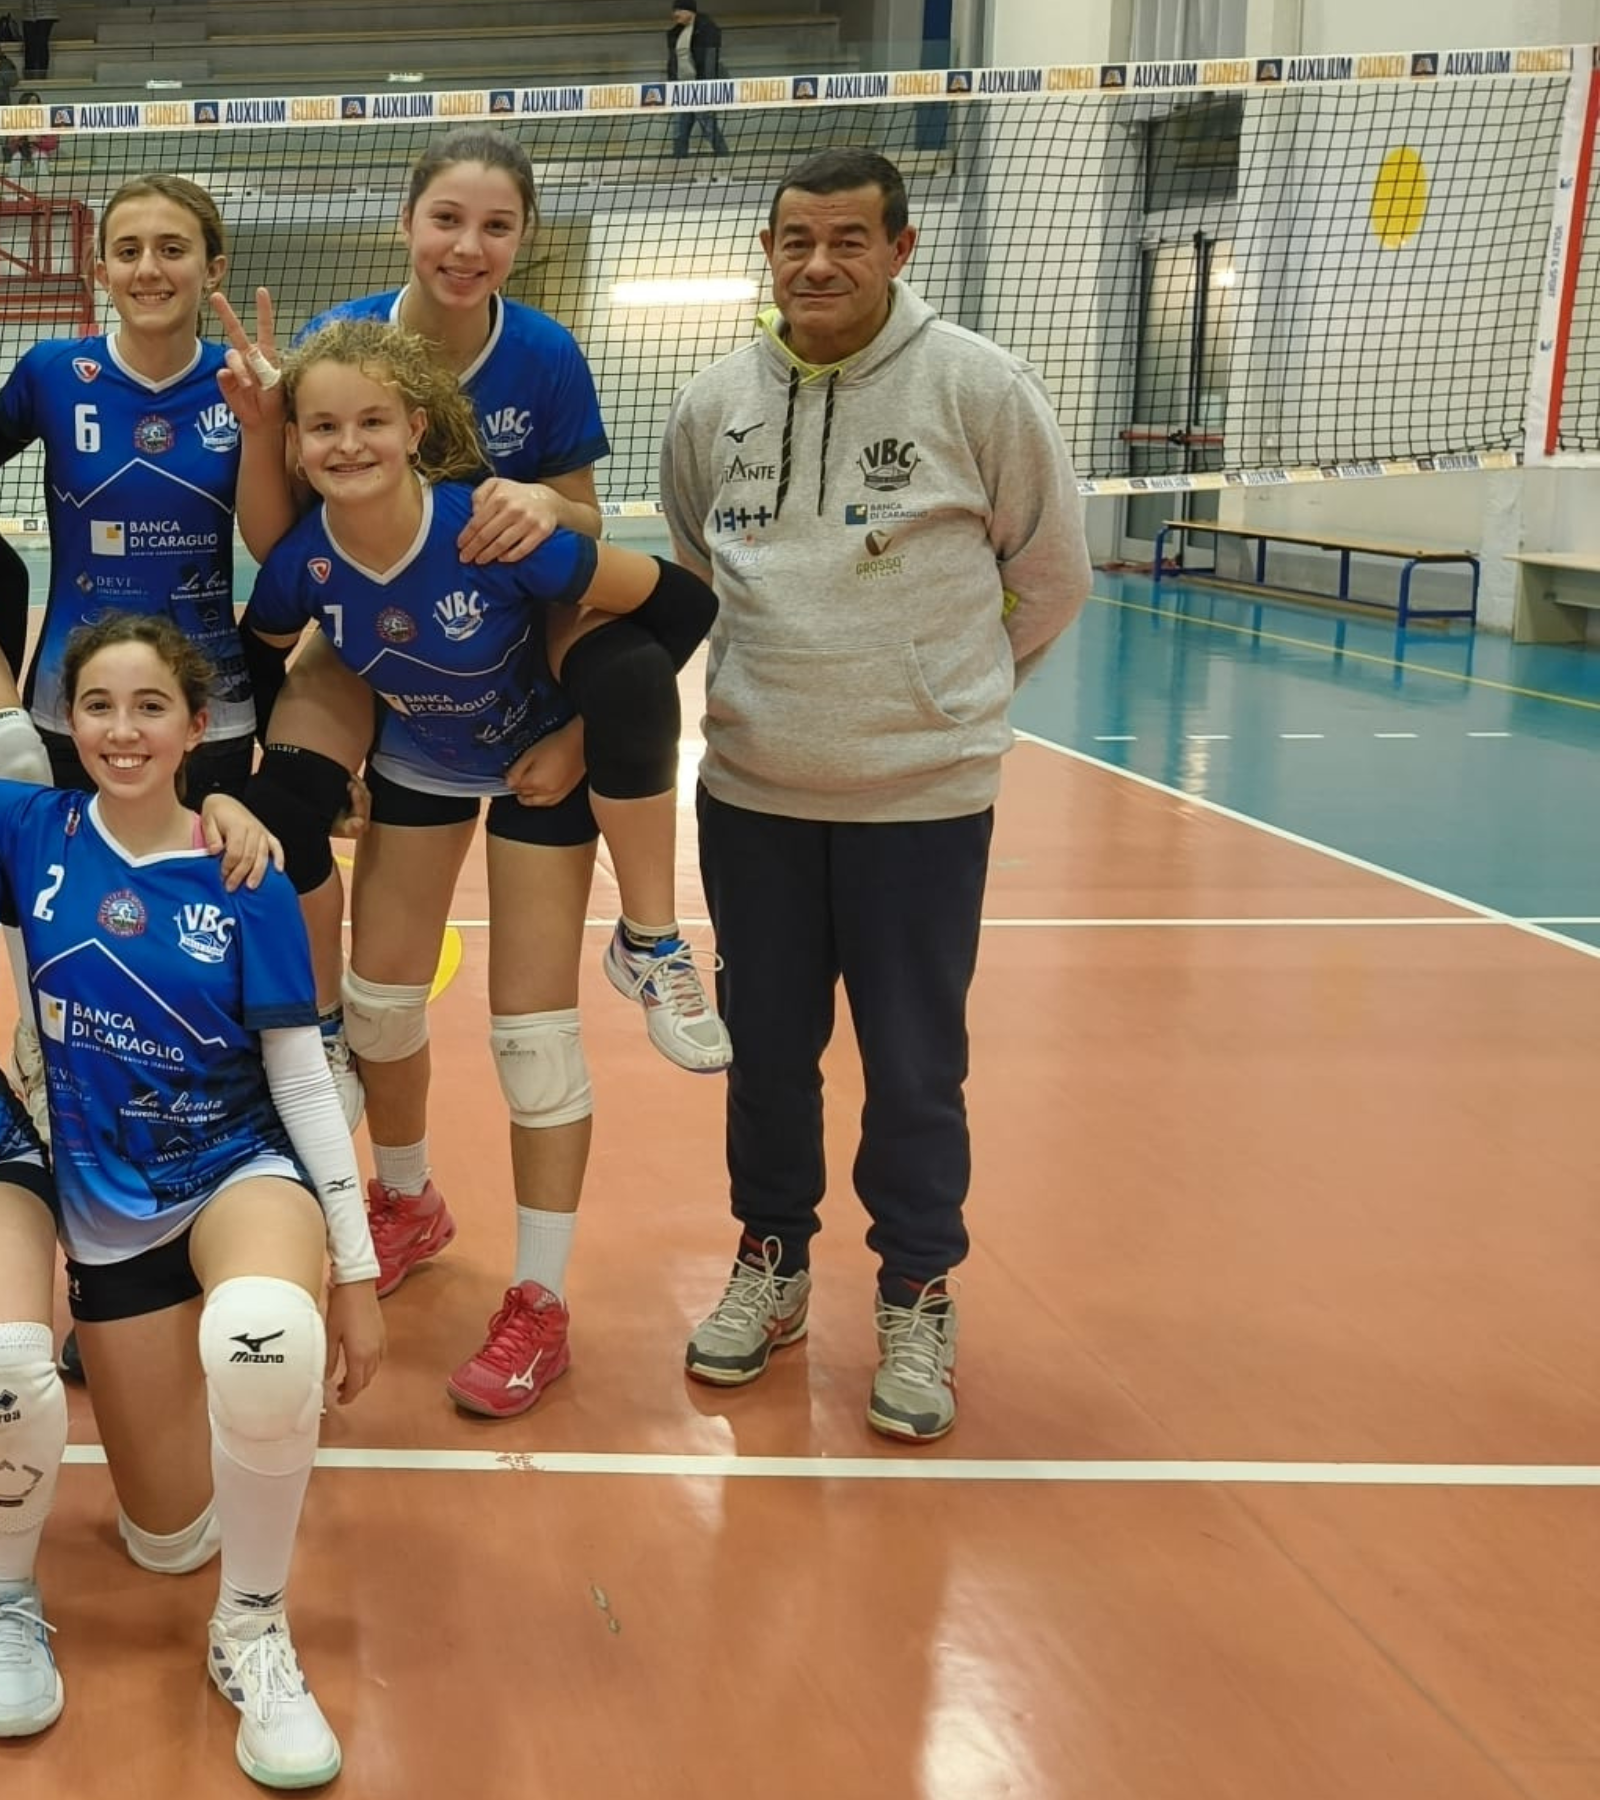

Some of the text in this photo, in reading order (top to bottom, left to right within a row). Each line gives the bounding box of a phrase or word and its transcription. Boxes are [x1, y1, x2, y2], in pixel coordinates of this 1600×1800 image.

[1287, 57, 1352, 82] AUXILIUM
[1444, 51, 1510, 75] AUXILIUM
[825, 75, 888, 99] AUXILIUM
[978, 69, 1042, 93] AUXILIUM
[1133, 64, 1197, 87] AUXILIUM
[521, 89, 583, 112] AUXILIUM
[671, 82, 734, 106] AUXILIUM
[80, 105, 138, 128] AUXILIUM
[226, 101, 285, 123] AUXILIUM
[373, 94, 433, 119] AUXILIUM
[74, 403, 101, 453] 6
[200, 403, 238, 432] VBC
[486, 406, 531, 436] VBC
[863, 438, 915, 469] VBC
[129, 520, 181, 533] BANCA
[129, 532, 218, 548] DI CARAGLIO
[856, 556, 901, 575] GROSSO
[96, 575, 131, 588] DEVI
[436, 590, 482, 621] VBC
[323, 604, 343, 649] 7
[402, 694, 454, 705] BANCA
[410, 689, 497, 714] DI CARAGLIO
[32, 864, 65, 922] 2
[184, 903, 235, 943] VBC
[72, 1002, 136, 1032] BANCA
[71, 1020, 185, 1063] DI CARAGLIO
[119, 1107, 160, 1119] Souvenir
